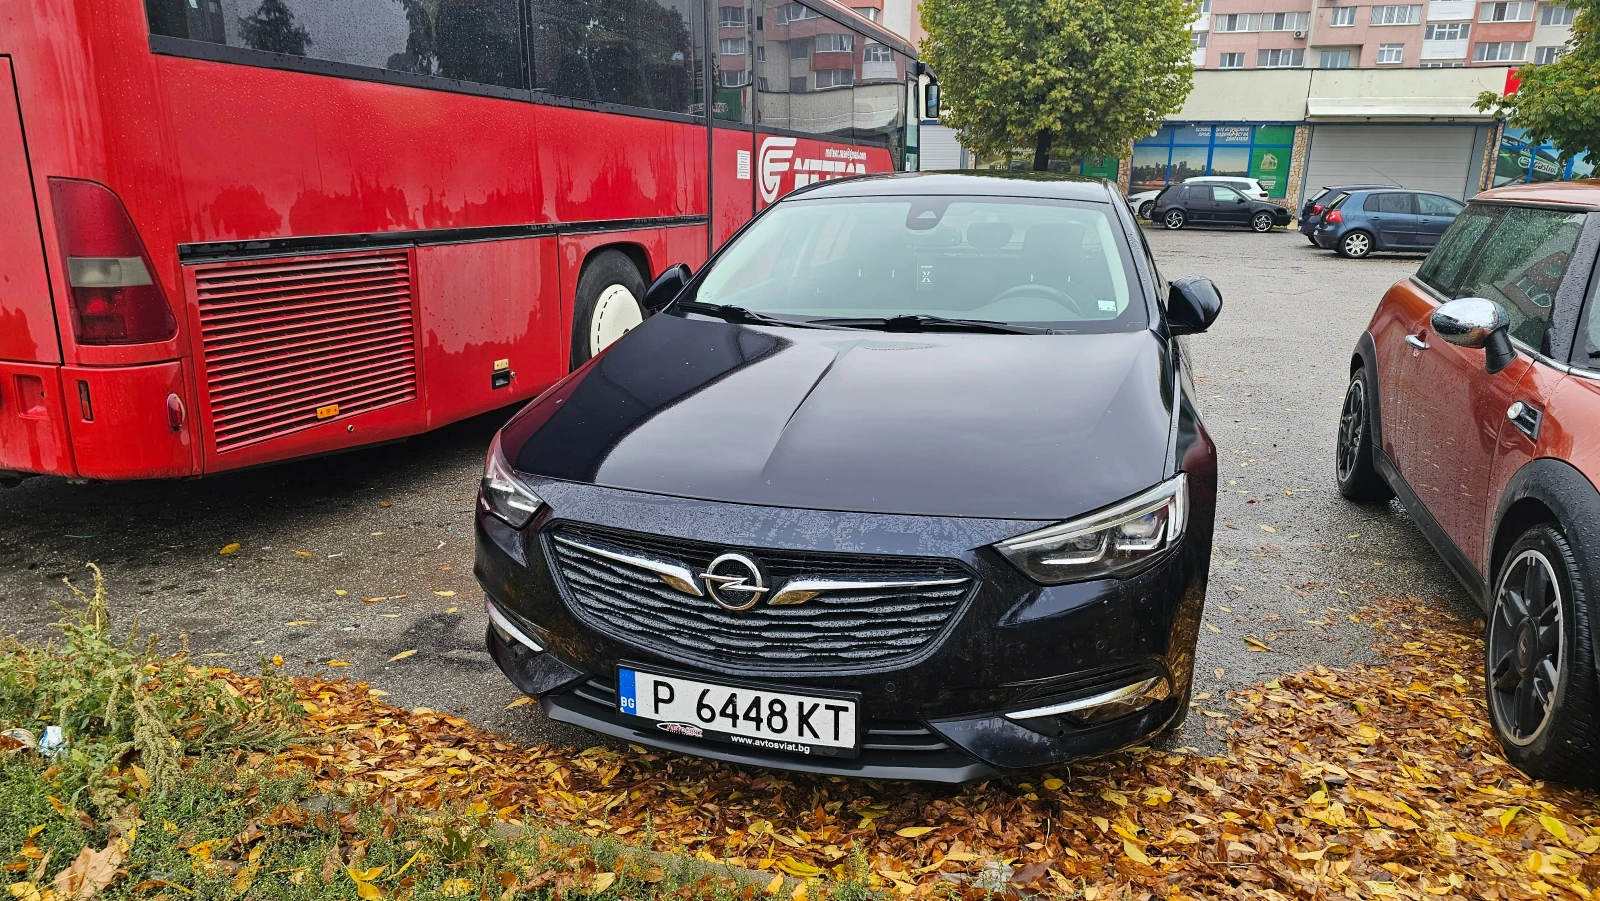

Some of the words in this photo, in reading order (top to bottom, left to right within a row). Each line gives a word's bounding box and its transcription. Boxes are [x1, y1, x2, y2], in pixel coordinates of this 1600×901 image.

[1533, 160, 1557, 174] Castrol
[620, 696, 635, 708] BG
[653, 680, 675, 714] P
[696, 689, 788, 734] 6448
[798, 701, 850, 741] KT
[730, 735, 811, 755] www.avtosviat.bg
